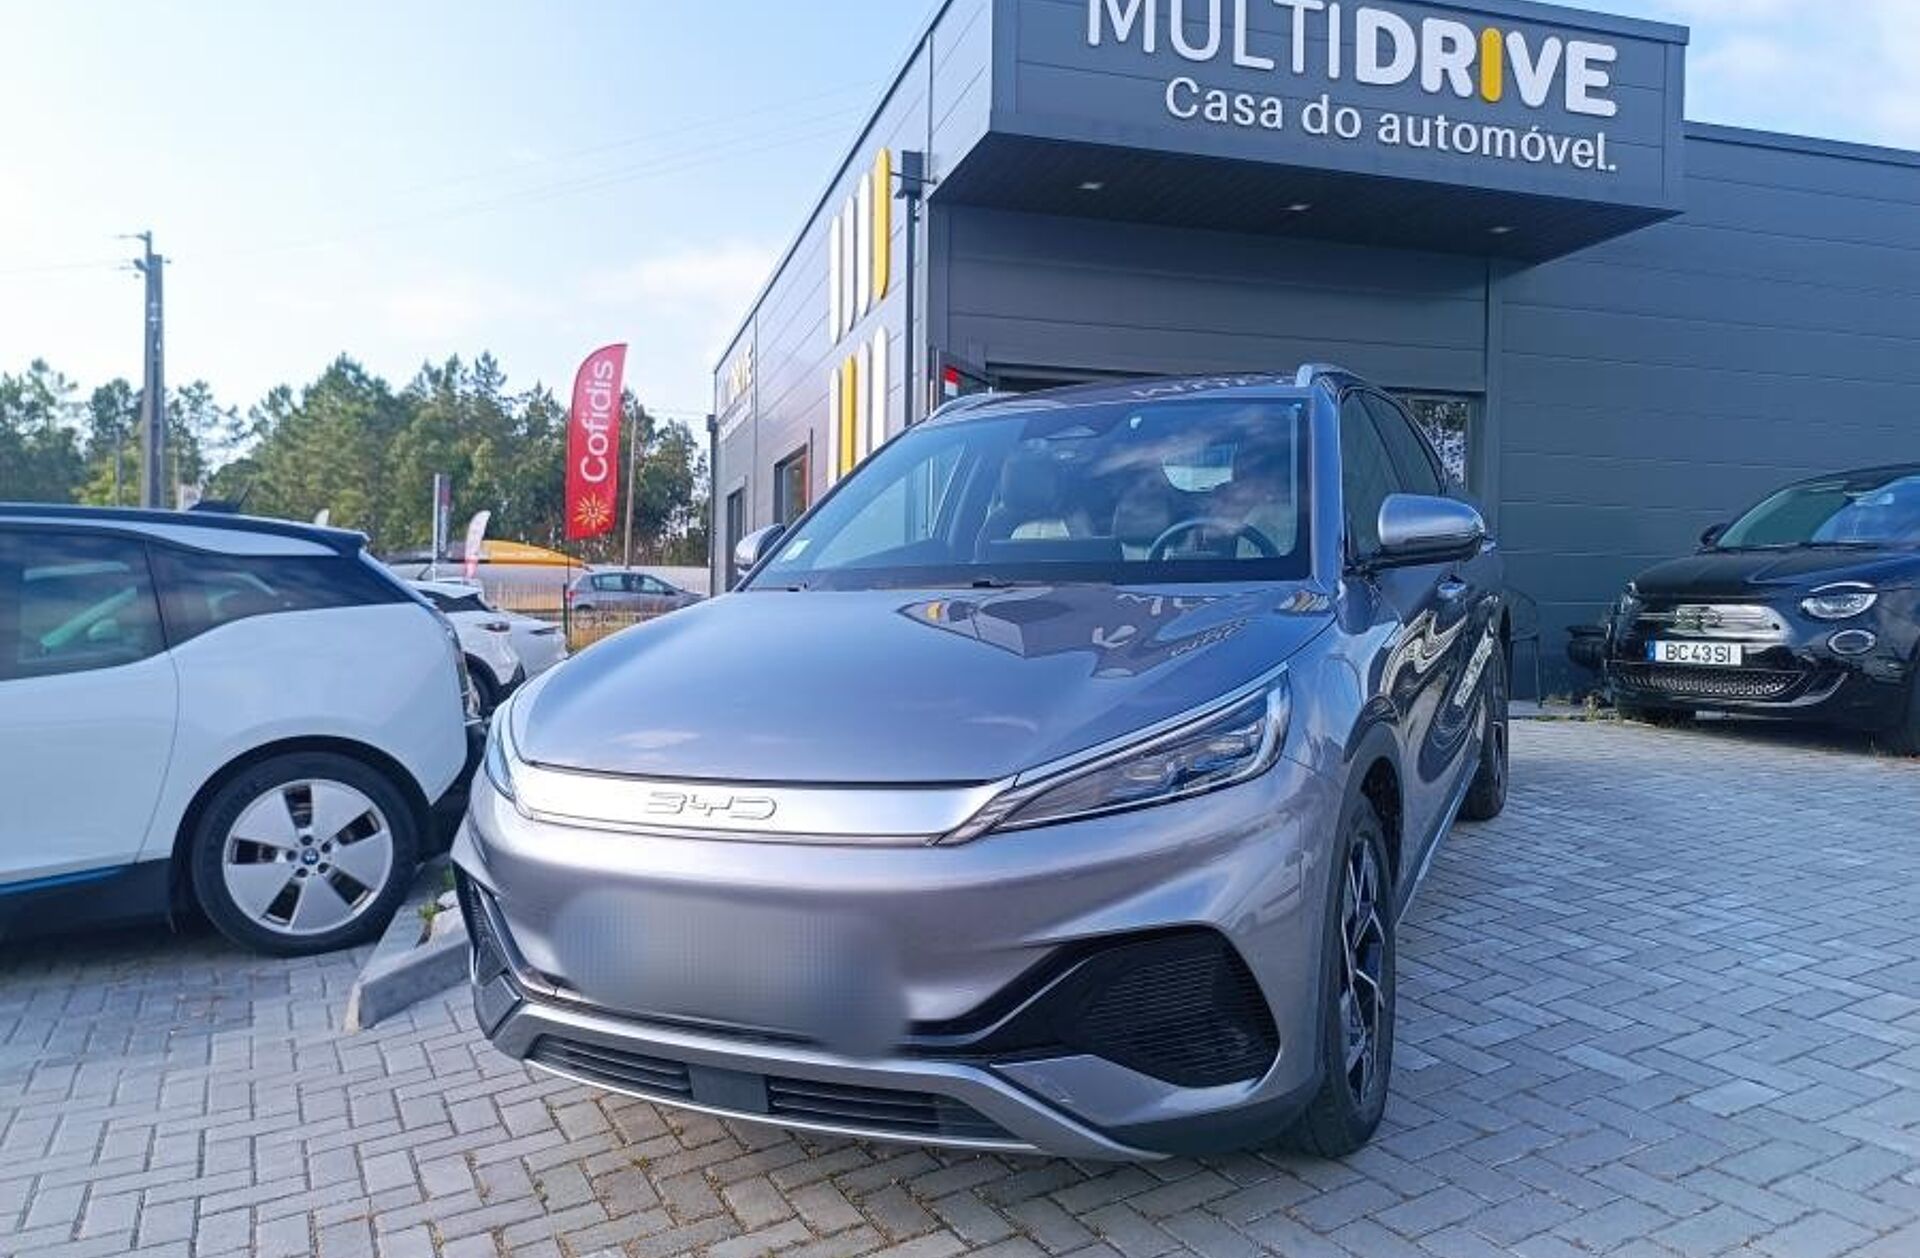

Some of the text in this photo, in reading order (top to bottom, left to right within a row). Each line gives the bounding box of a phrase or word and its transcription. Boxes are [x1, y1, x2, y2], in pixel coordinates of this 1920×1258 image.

[1088, 0, 1617, 117] MULTIDRIVE
[1166, 77, 1616, 171] Casa do automóvel.
[580, 360, 614, 482] Cofidis
[647, 791, 777, 820] BYD
